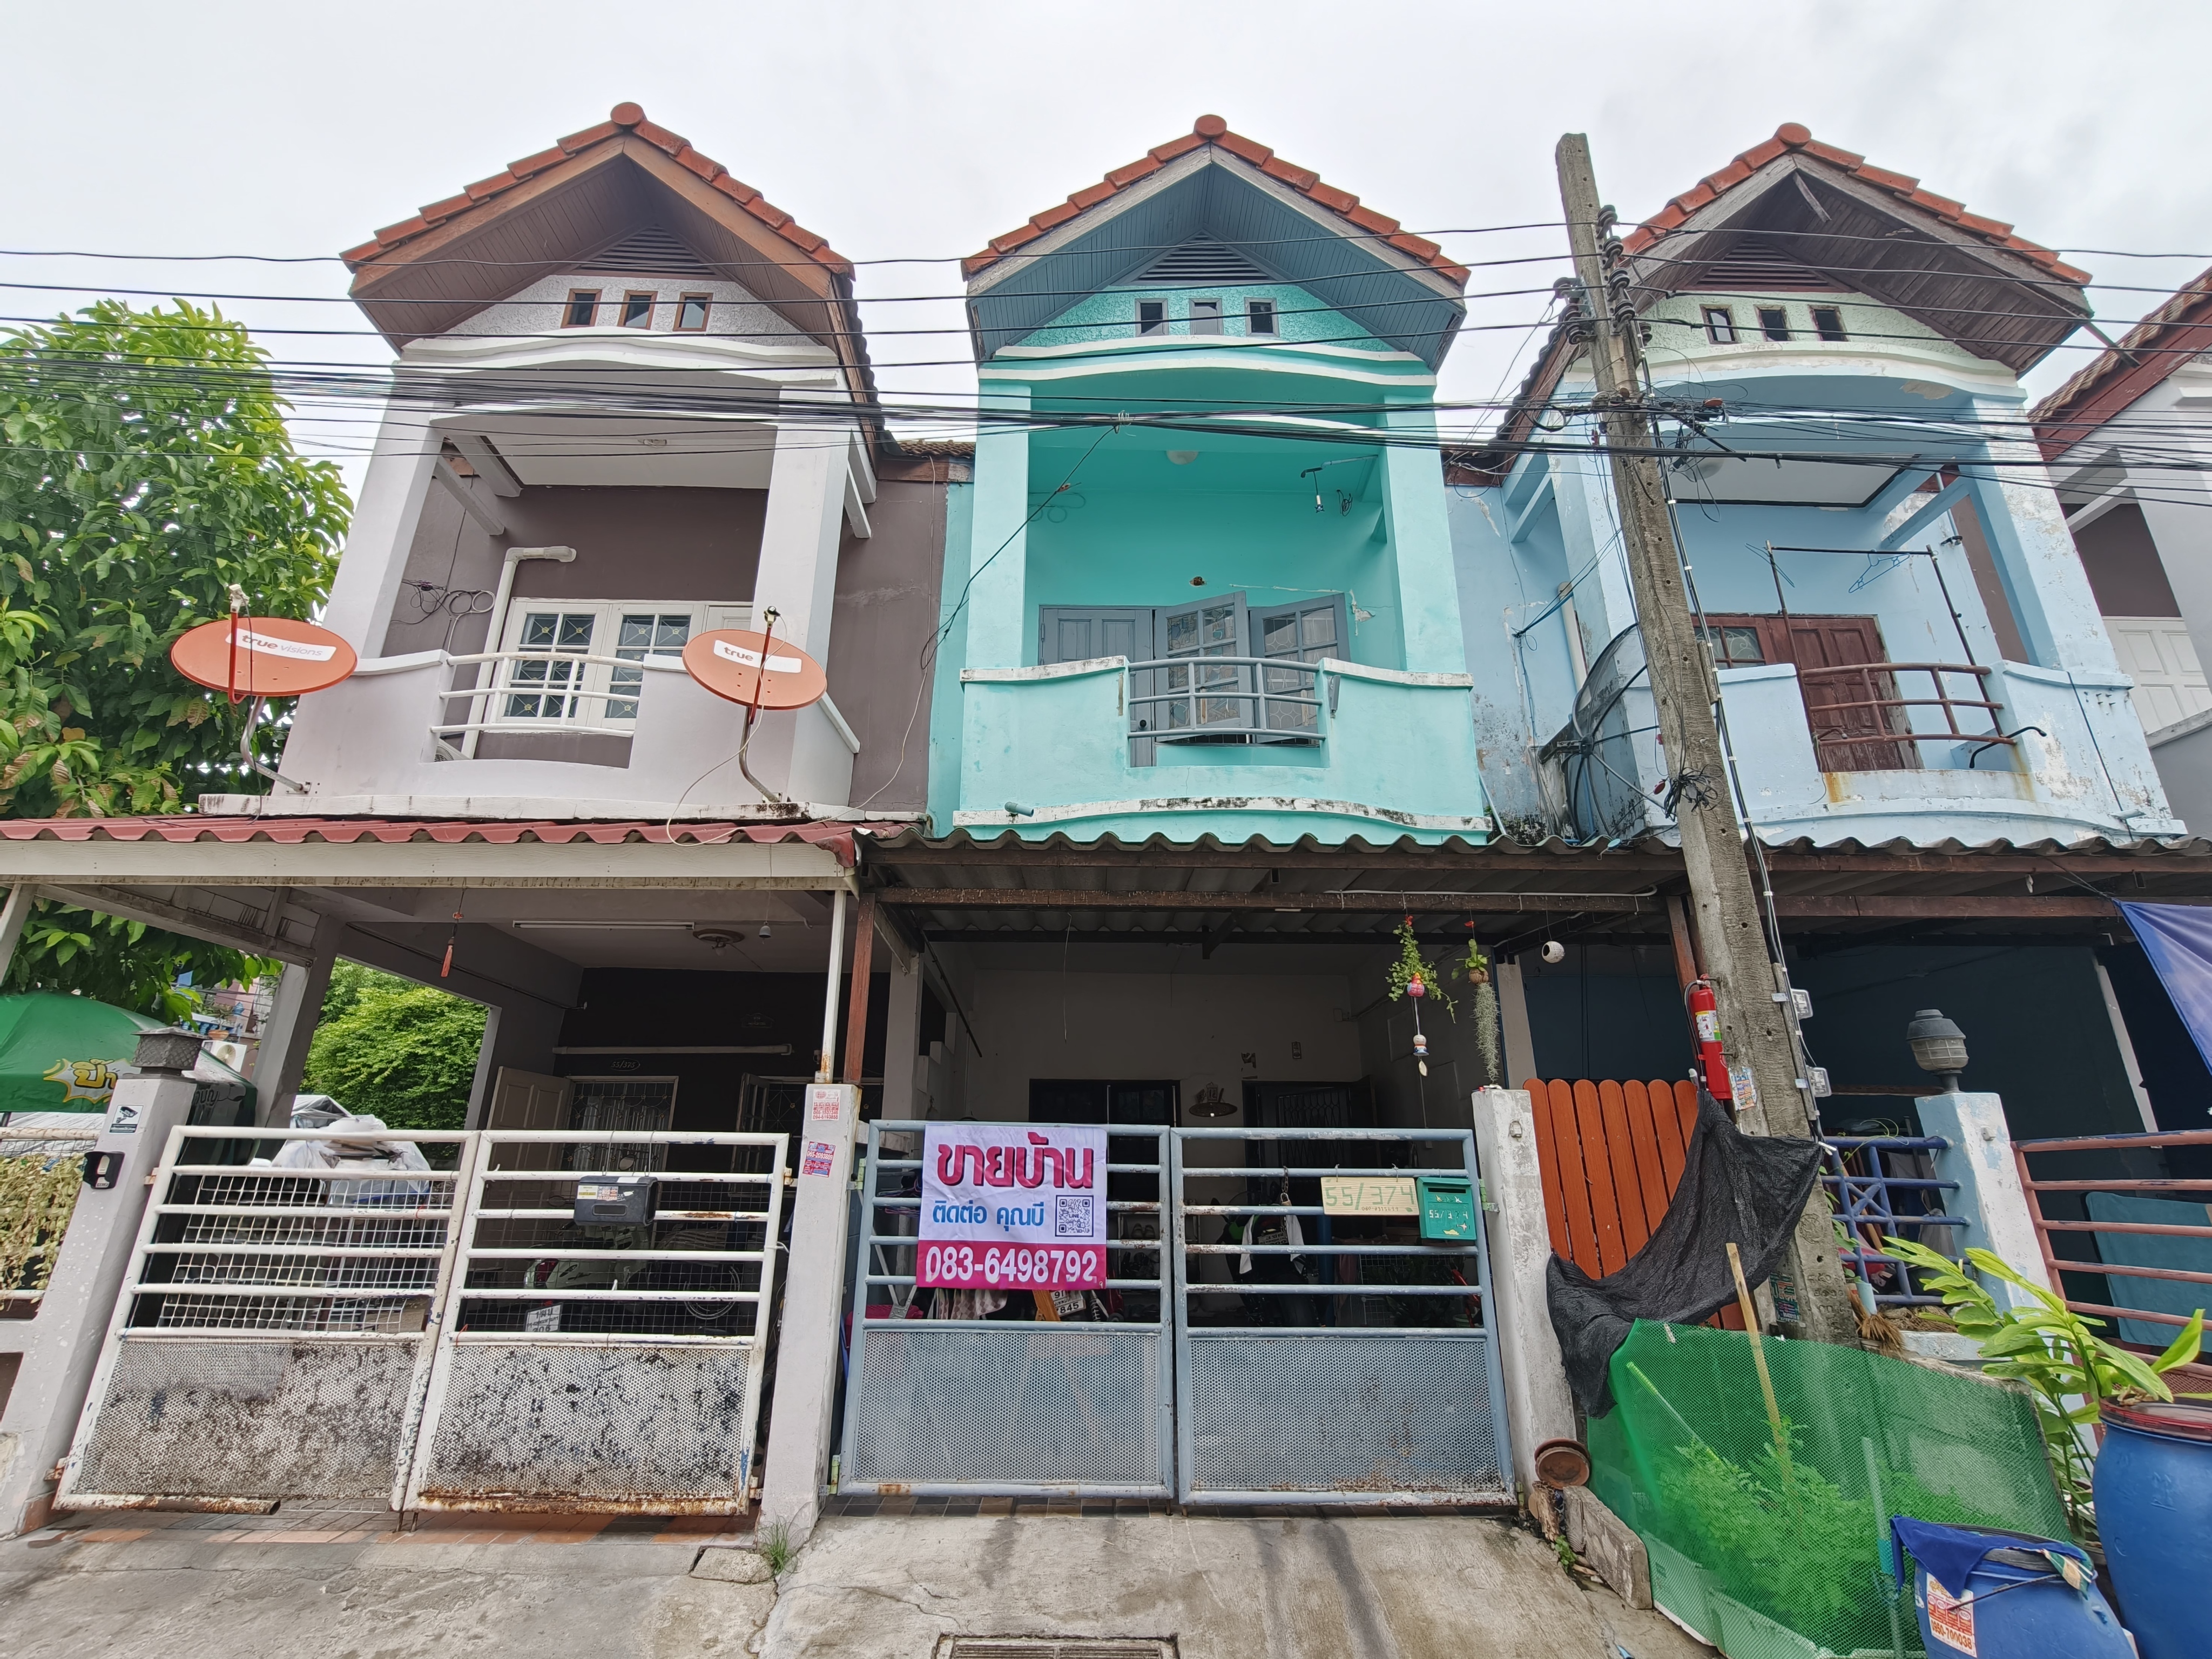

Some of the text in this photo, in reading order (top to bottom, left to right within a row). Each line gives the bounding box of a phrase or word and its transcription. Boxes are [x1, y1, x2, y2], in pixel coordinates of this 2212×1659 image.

[242, 635, 323, 656] true visions
[724, 646, 754, 661] true
[610, 1060, 637, 1069] 55/375
[937, 1131, 1094, 1189] ขายบ้าน
[1325, 1183, 1415, 1210] 55/374
[932, 1199, 1044, 1232] ติดต่อ คุณบี
[925, 1245, 1097, 1284] 083-6498792
